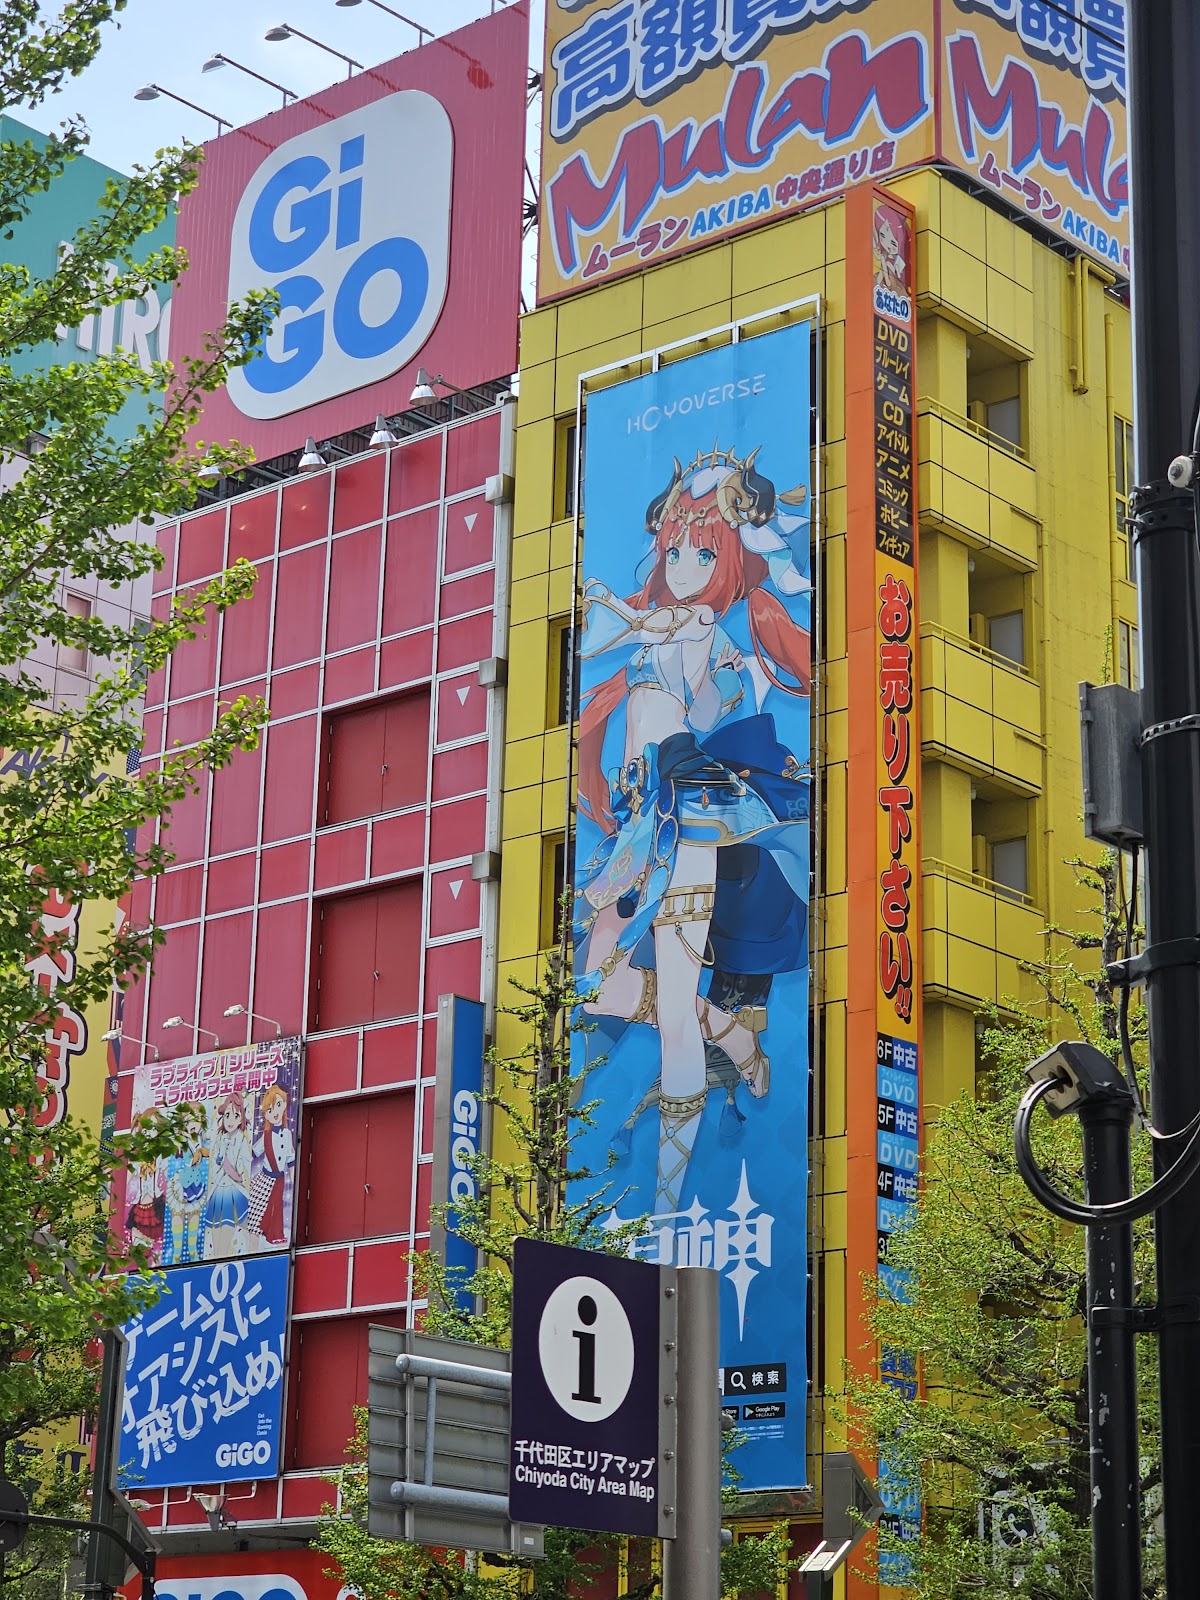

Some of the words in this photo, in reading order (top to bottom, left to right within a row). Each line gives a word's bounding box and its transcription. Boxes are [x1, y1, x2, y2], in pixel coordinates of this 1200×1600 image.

[549, 33, 931, 276] Mulan
[582, 218, 690, 279] ムーラン
[690, 187, 771, 238] AKIBA
[775, 140, 896, 206] 中央通り店
[980, 152, 1061, 220] ムーラン
[1062, 215, 1120, 265] AKIBA
[875, 288, 909, 318] あなたの
[877, 318, 909, 353] DVD
[875, 345, 910, 380] ブルーレイ
[626, 373, 767, 435] HOYOVERSE
[876, 371, 910, 406] ゲーム
[882, 400, 905, 427] CD
[876, 422, 910, 456] アイドル
[876, 448, 911, 480] アニメ
[878, 477, 909, 507] コミック
[880, 503, 909, 530] ホビー
[878, 529, 911, 560] フィギュア
[877, 1038, 893, 1061] 6F
[893, 1043, 917, 1071] 中古
[153, 1067, 279, 1108] コラボカフェ展開中
[881, 1079, 915, 1104] DVD
[878, 1103, 895, 1126] 5F
[895, 1107, 918, 1135] 中古
[880, 1142, 917, 1170] DVD
[878, 1170, 893, 1191] 4F
[751, 1370, 779, 1387] 検索
[514, 1439, 656, 1479] 千代田区エリアマップ
[514, 1464, 568, 1489] Chiyoda
[569, 1472, 595, 1496] City
[597, 1476, 627, 1496] Area
[629, 1480, 655, 1503] Map
